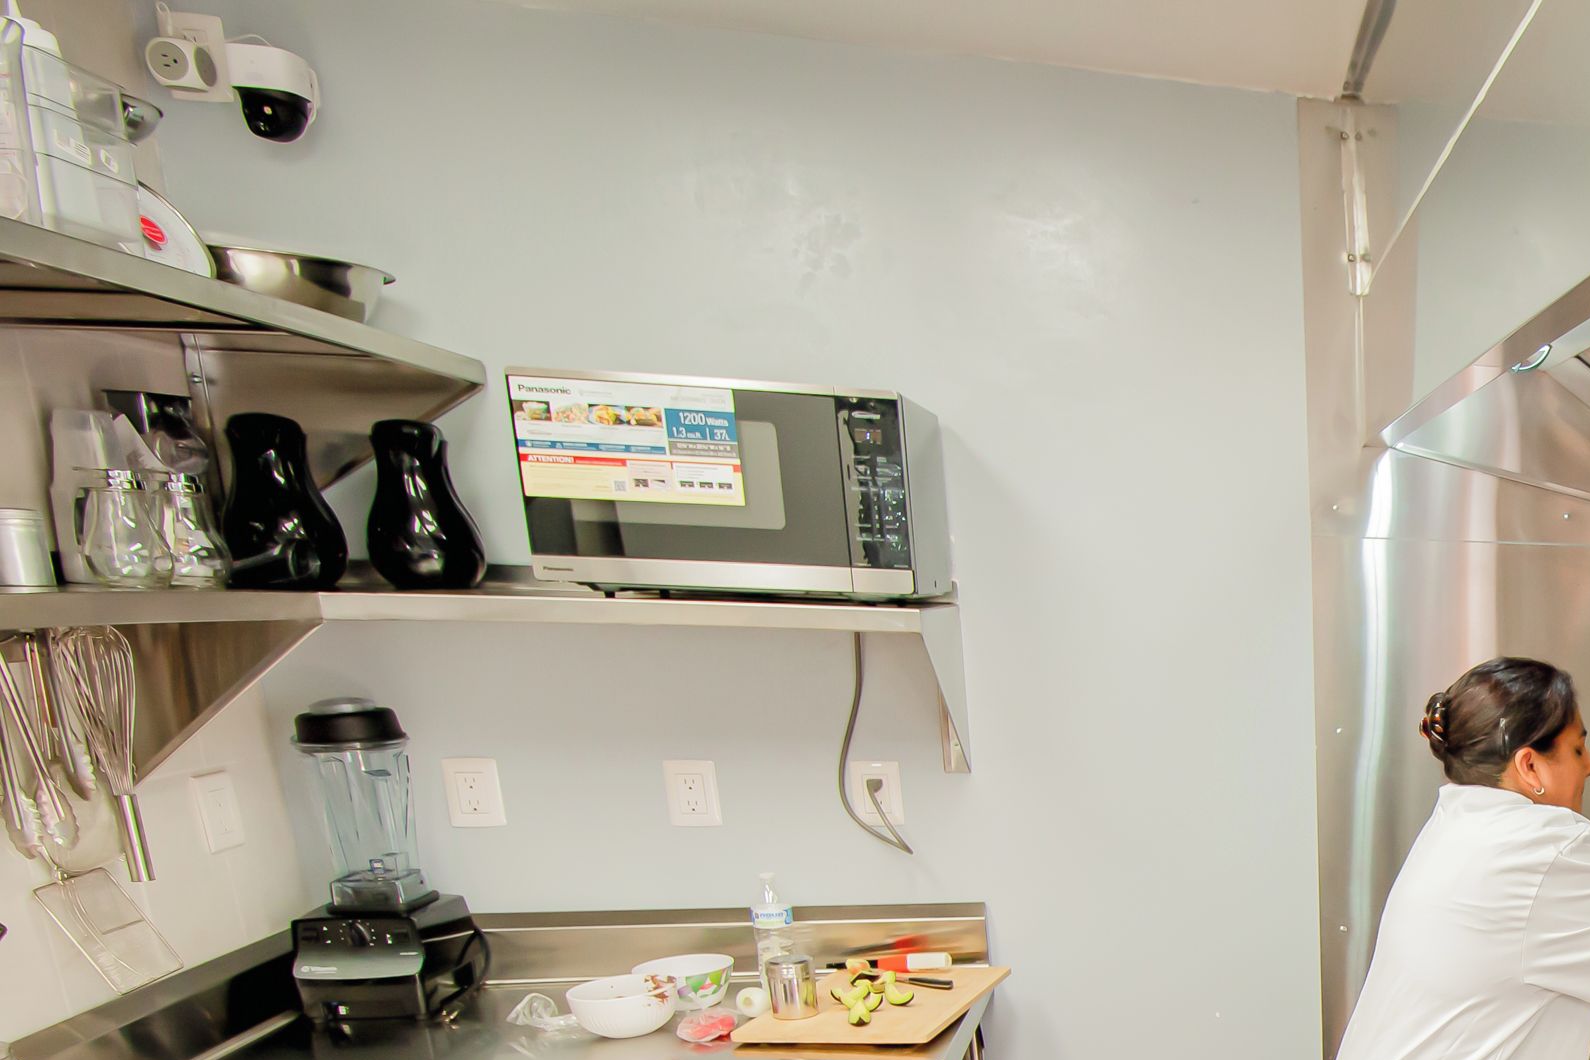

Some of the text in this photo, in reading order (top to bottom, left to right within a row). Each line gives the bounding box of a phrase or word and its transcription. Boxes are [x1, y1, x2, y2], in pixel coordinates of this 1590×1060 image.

[517, 383, 572, 395] Panasonic
[678, 411, 706, 425] 1200
[527, 454, 575, 464] ATTENTION!
